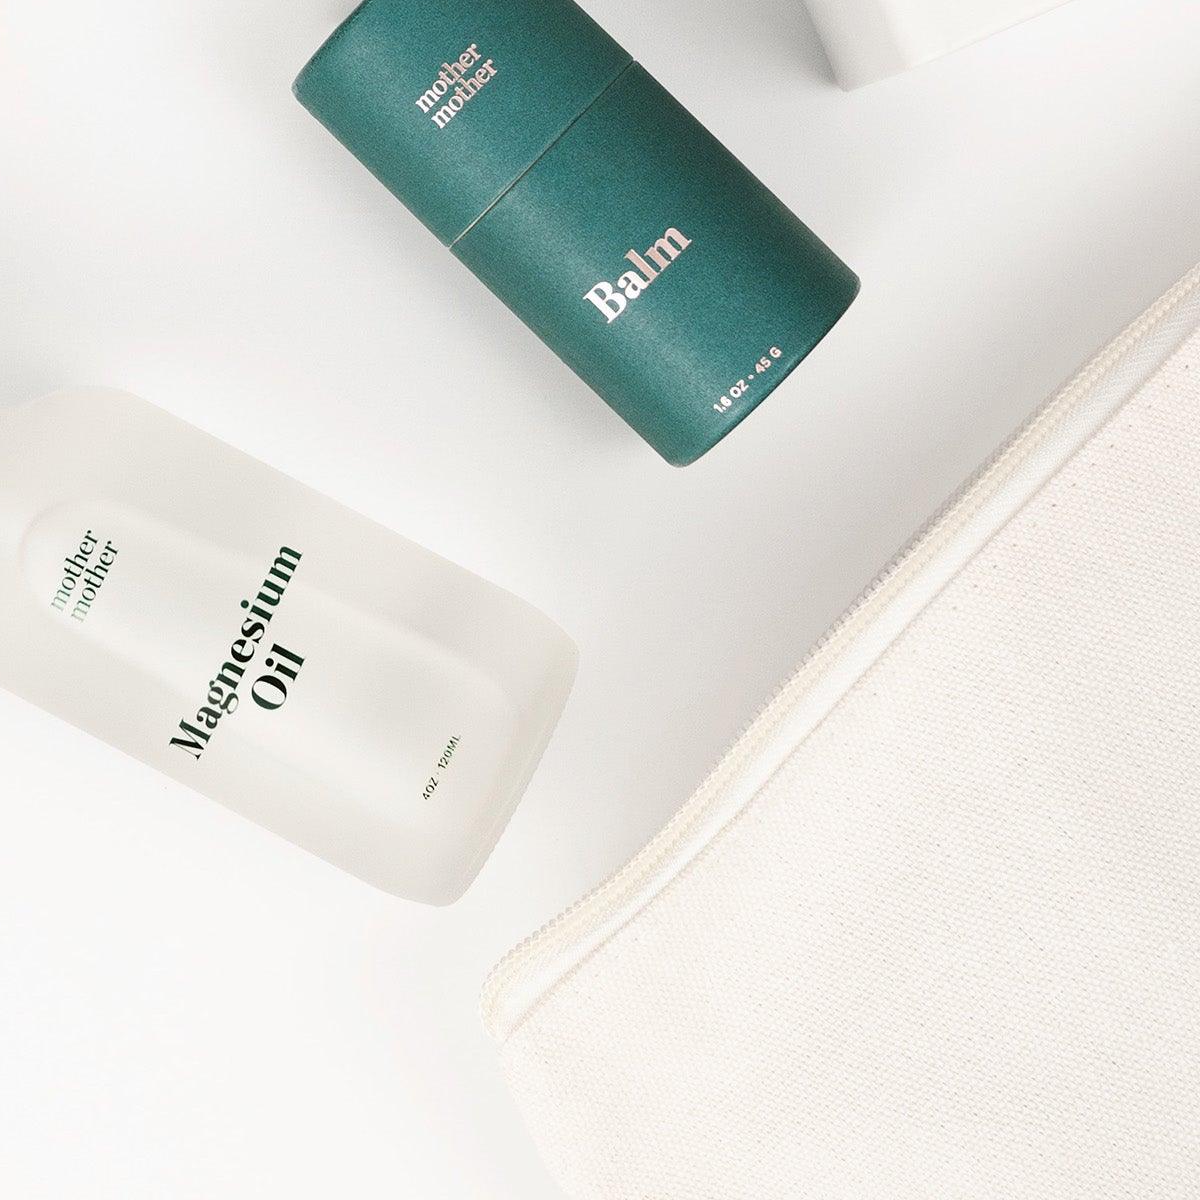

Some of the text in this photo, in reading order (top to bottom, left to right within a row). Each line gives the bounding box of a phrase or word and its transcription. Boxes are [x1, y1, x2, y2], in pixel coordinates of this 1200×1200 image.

[415, 43, 481, 113] mother
[431, 59, 497, 129] mother
[582, 227, 692, 324] Balm
[713, 346, 782, 413] 1.6 OZ 45 G
[50, 529, 98, 612] mother
[70, 540, 119, 623] mother
[169, 546, 303, 760] Magnesium
[251, 643, 305, 710] Oil
